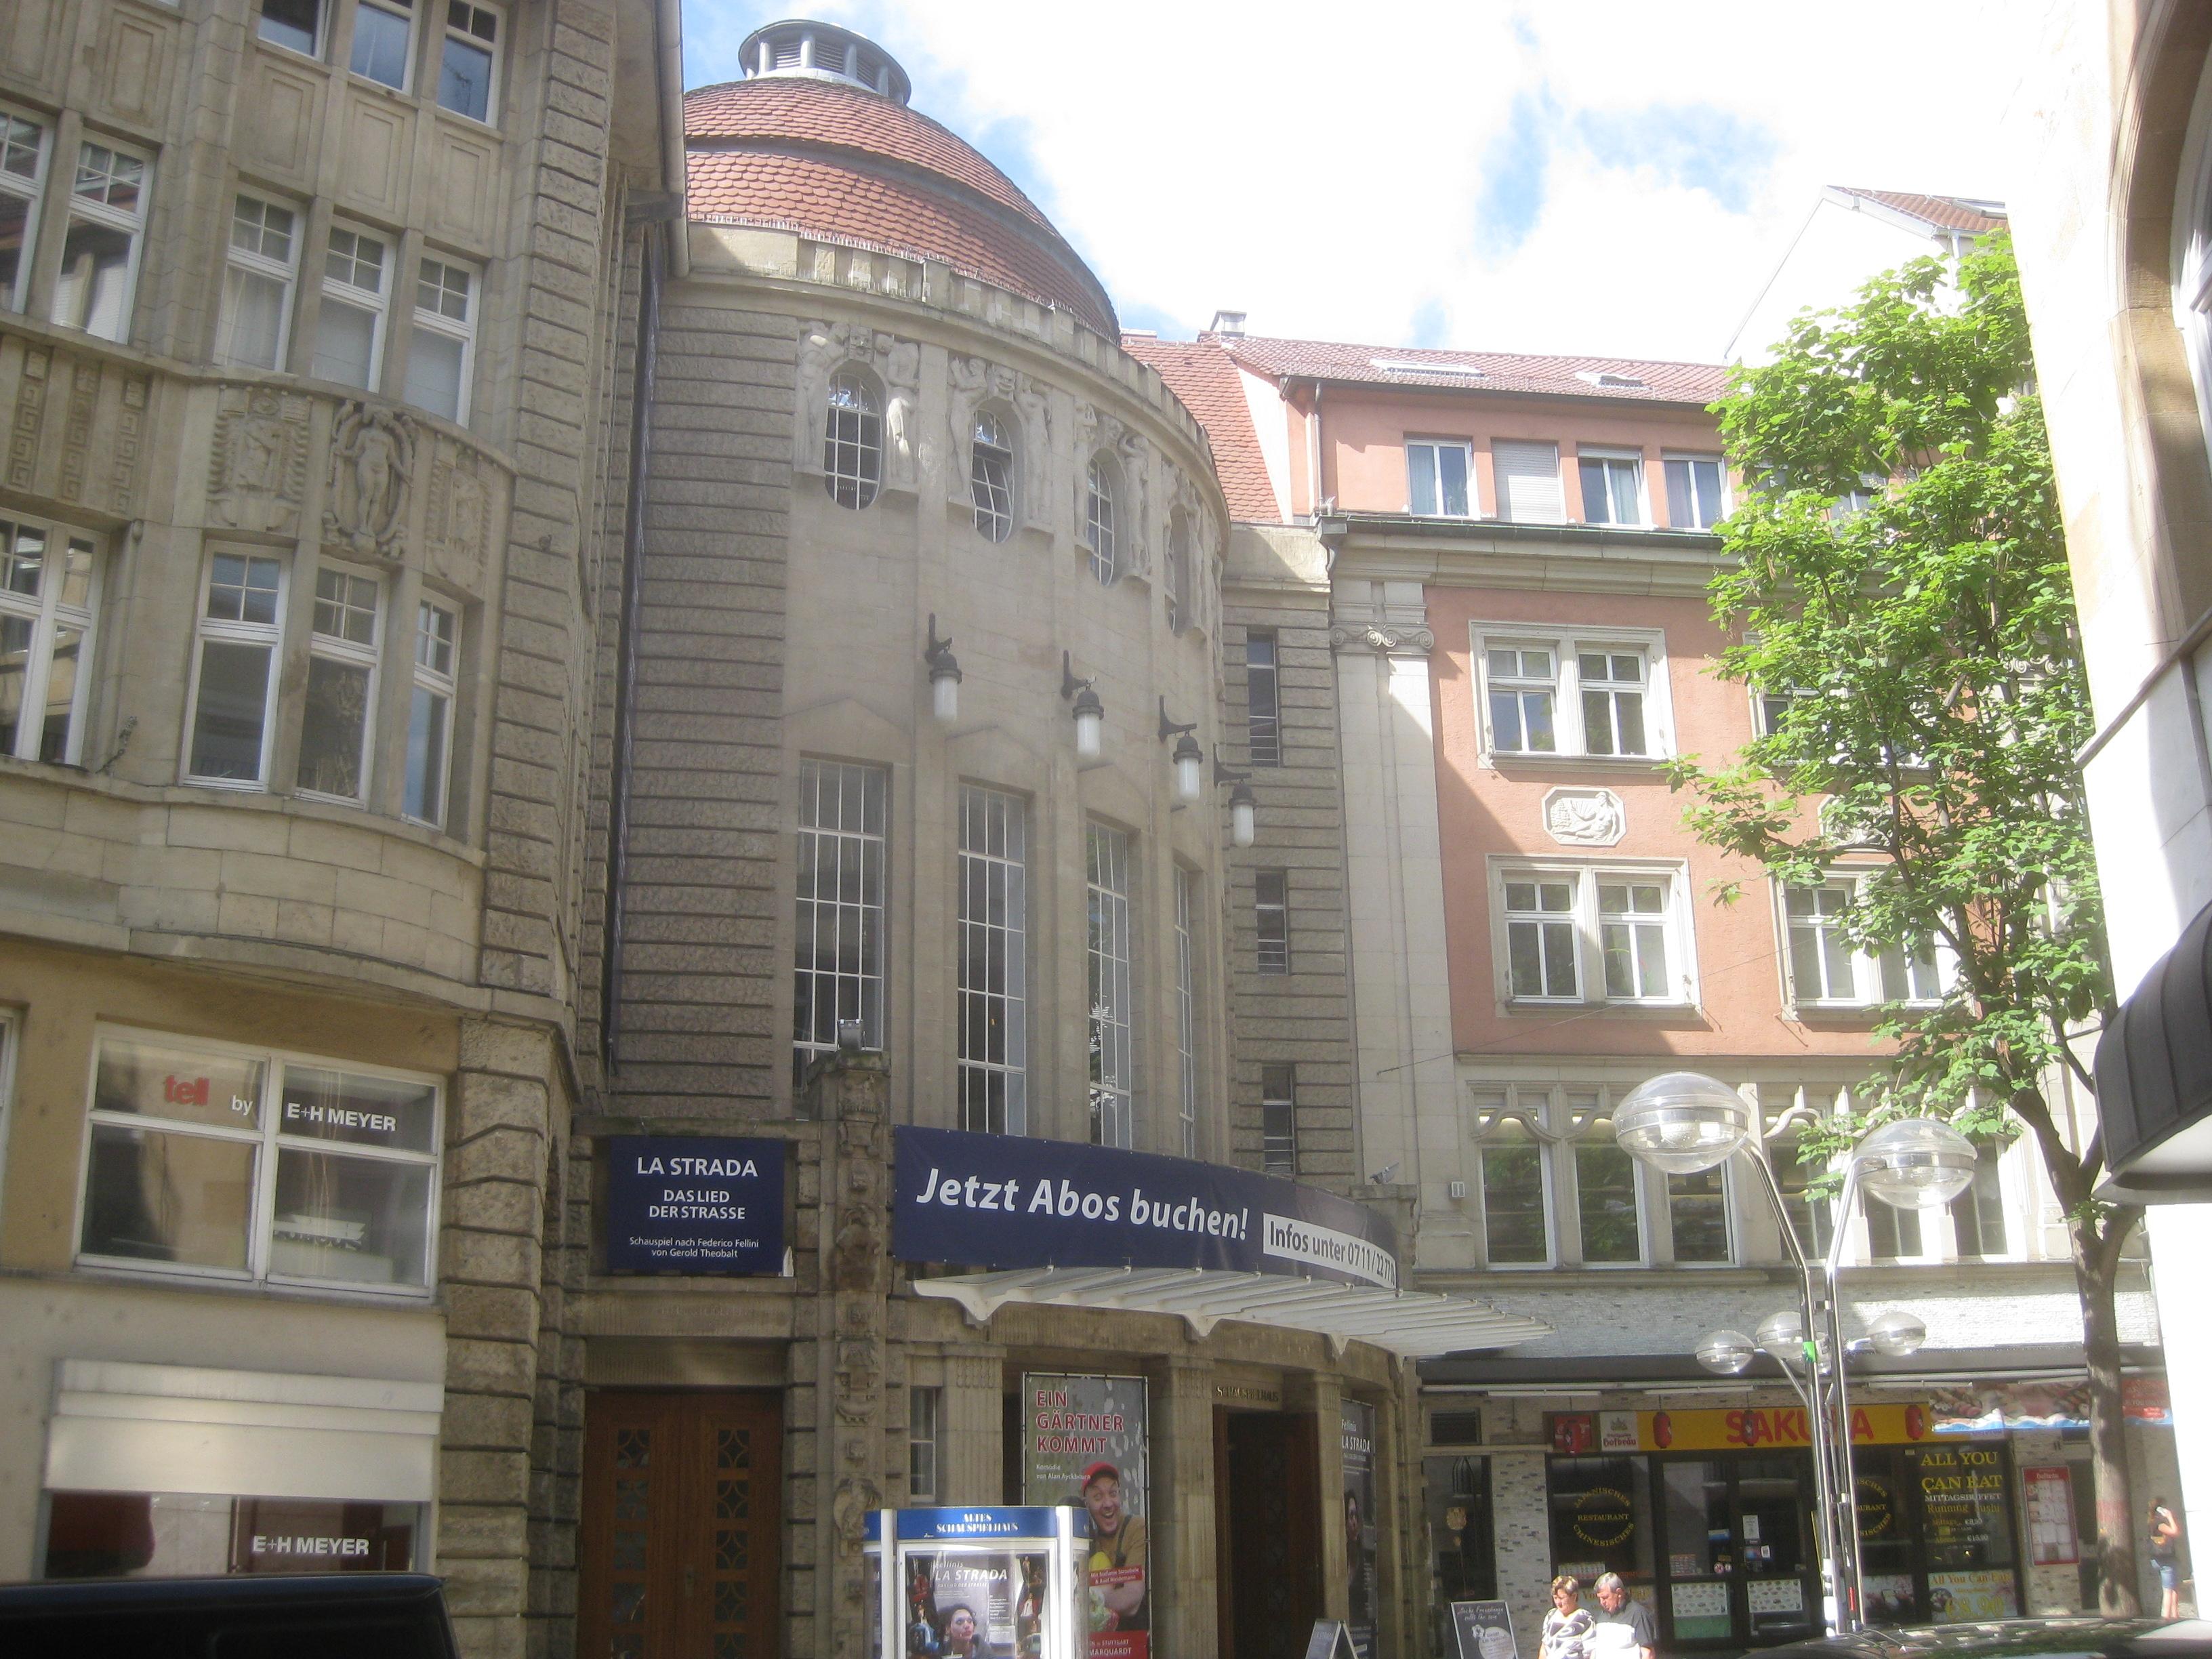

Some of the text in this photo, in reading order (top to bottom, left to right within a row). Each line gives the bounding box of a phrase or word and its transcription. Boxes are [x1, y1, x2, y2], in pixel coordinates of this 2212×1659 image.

[230, 1095, 253, 1115] by
[287, 1102, 324, 1122] E+H
[328, 1109, 397, 1131] MEYER
[638, 1157, 758, 1177] LA STRADA
[663, 1189, 731, 1203] DAS LIED
[916, 1168, 1248, 1241] Jetzt Abos buchen!
[649, 1206, 746, 1220] DER STRASSE
[630, 1237, 759, 1248] Schauspiel nach Federico Fellini
[1270, 1221, 1309, 1253] Infos
[1312, 1235, 1346, 1263] unter
[670, 1248, 698, 1257] Gerold
[701, 1248, 738, 1258] Theobalt
[1036, 1389, 1067, 1408] EIN
[1036, 1409, 1124, 1432] GÄRTNER
[1725, 1408, 1875, 1443] SAKUA
[1036, 1435, 1107, 1454] KOMMT
[1342, 1435, 1370, 1453] LA STRADA
[1921, 1451, 1998, 1466] ALL YOU
[1921, 1474, 2003, 1490] CAN EAT
[1927, 1503, 1969, 1514] Running
[963, 1513, 992, 1523] ALTES
[1578, 1513, 1629, 1521] RESTAURANT
[936, 1522, 1019, 1533] SCHAUSPIELHAUS
[253, 1535, 370, 1555] E+H MEYER
[935, 1569, 1008, 1581] LA STRADA
